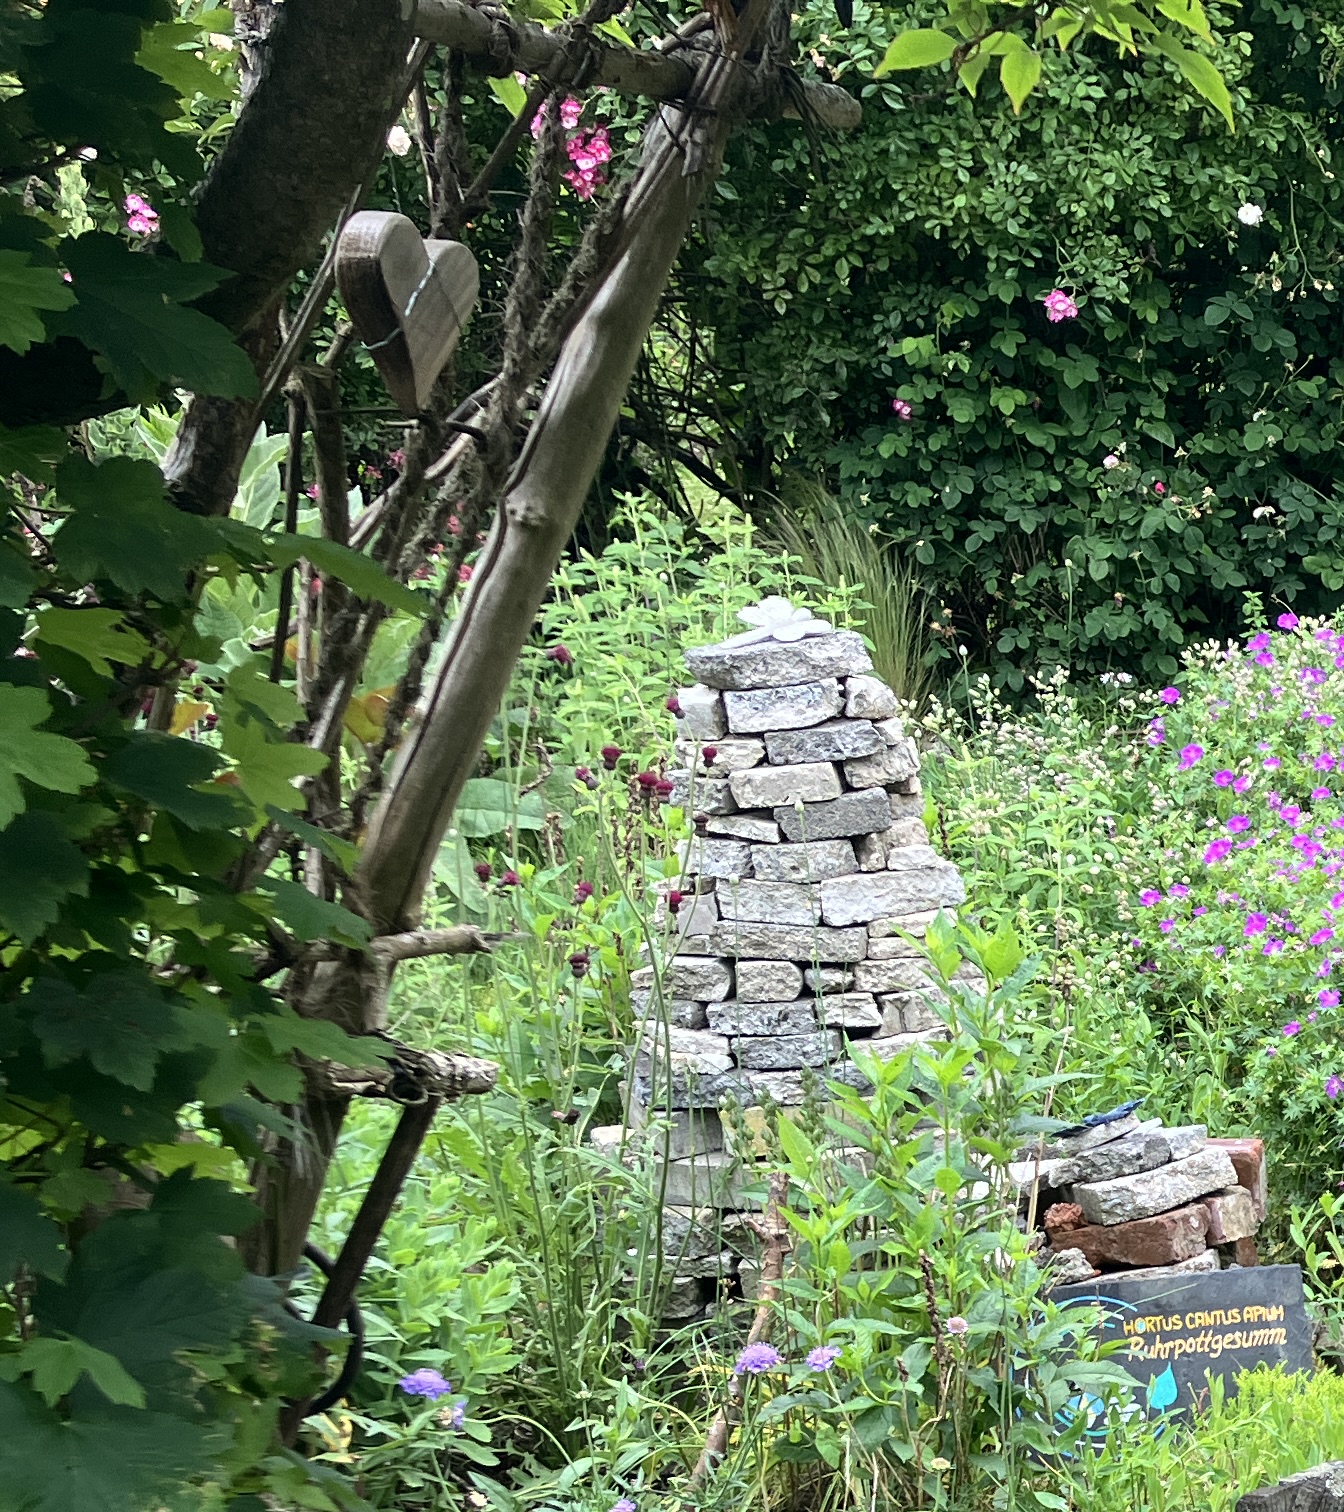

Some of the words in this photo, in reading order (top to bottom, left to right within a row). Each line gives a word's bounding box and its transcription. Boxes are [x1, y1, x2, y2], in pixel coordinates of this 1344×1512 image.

[1123, 1313, 1183, 1336] HORTUS
[1185, 1307, 1242, 1330] CANTUS
[1243, 1304, 1285, 1323] APIUM
[1127, 1326, 1288, 1362] Ruhrpottgesumm
